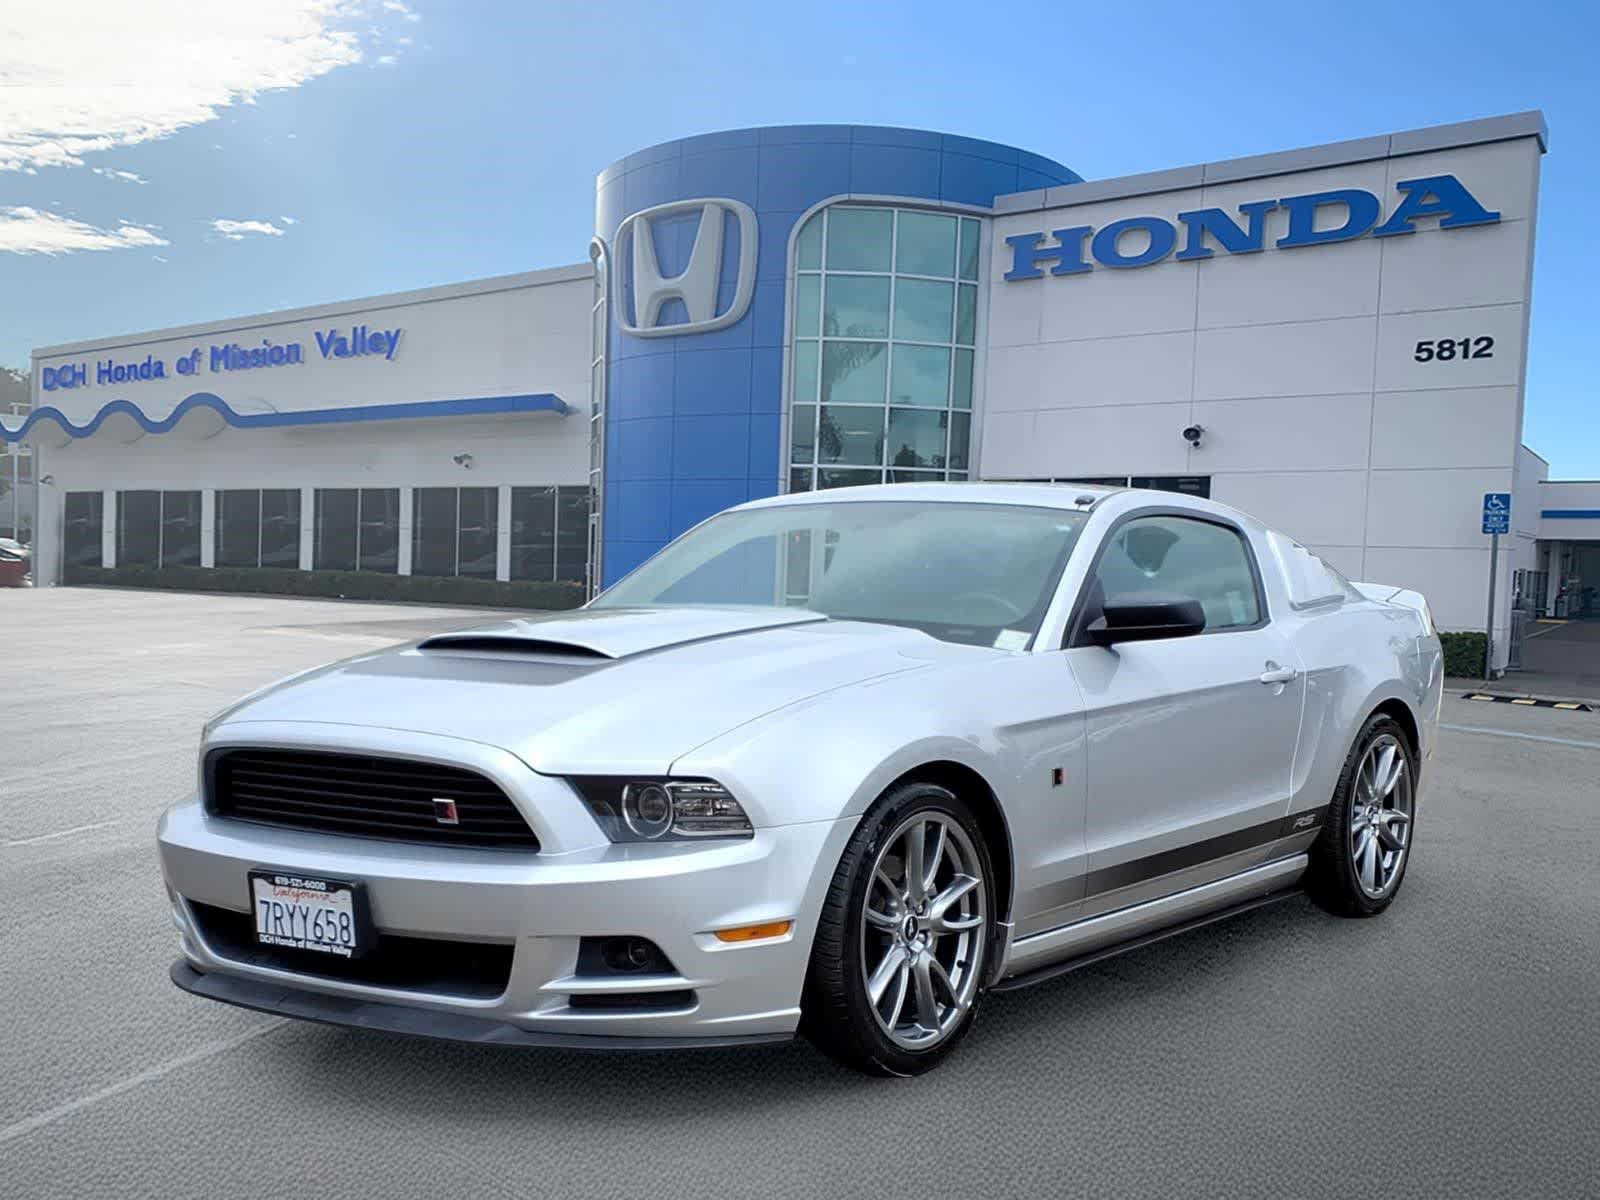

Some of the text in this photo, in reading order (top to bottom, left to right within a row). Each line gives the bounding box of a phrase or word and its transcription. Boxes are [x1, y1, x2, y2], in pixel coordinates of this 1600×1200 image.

[1003, 174, 1501, 281] HONDA
[42, 325, 402, 391] DCH Honda of Mission Valley
[1414, 336, 1495, 363] 5812
[259, 899, 352, 944] 7RYY658
